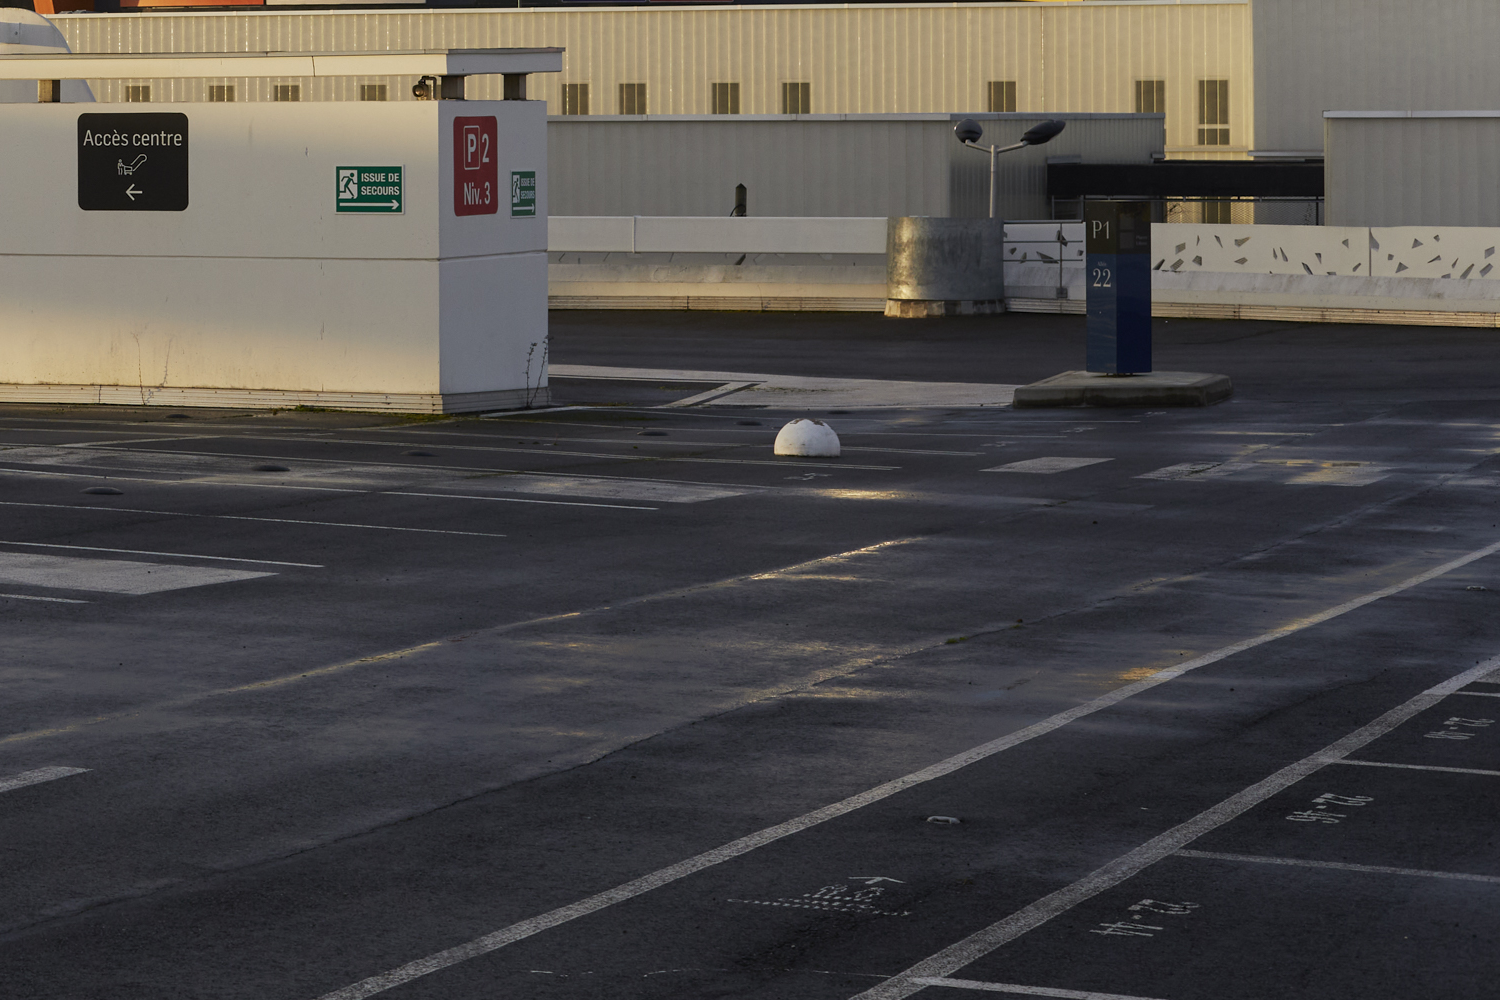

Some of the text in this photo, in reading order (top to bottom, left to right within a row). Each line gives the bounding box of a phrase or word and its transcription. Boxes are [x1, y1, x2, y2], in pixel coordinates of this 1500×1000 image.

[83, 129, 183, 147] Accès centre
[467, 133, 490, 163] P 2
[361, 172, 400, 183] ISSUE DE
[361, 186, 400, 196] SECOURS
[463, 181, 491, 206] Niv. 3
[1092, 220, 1110, 240] P1
[1093, 268, 1112, 288] 22
